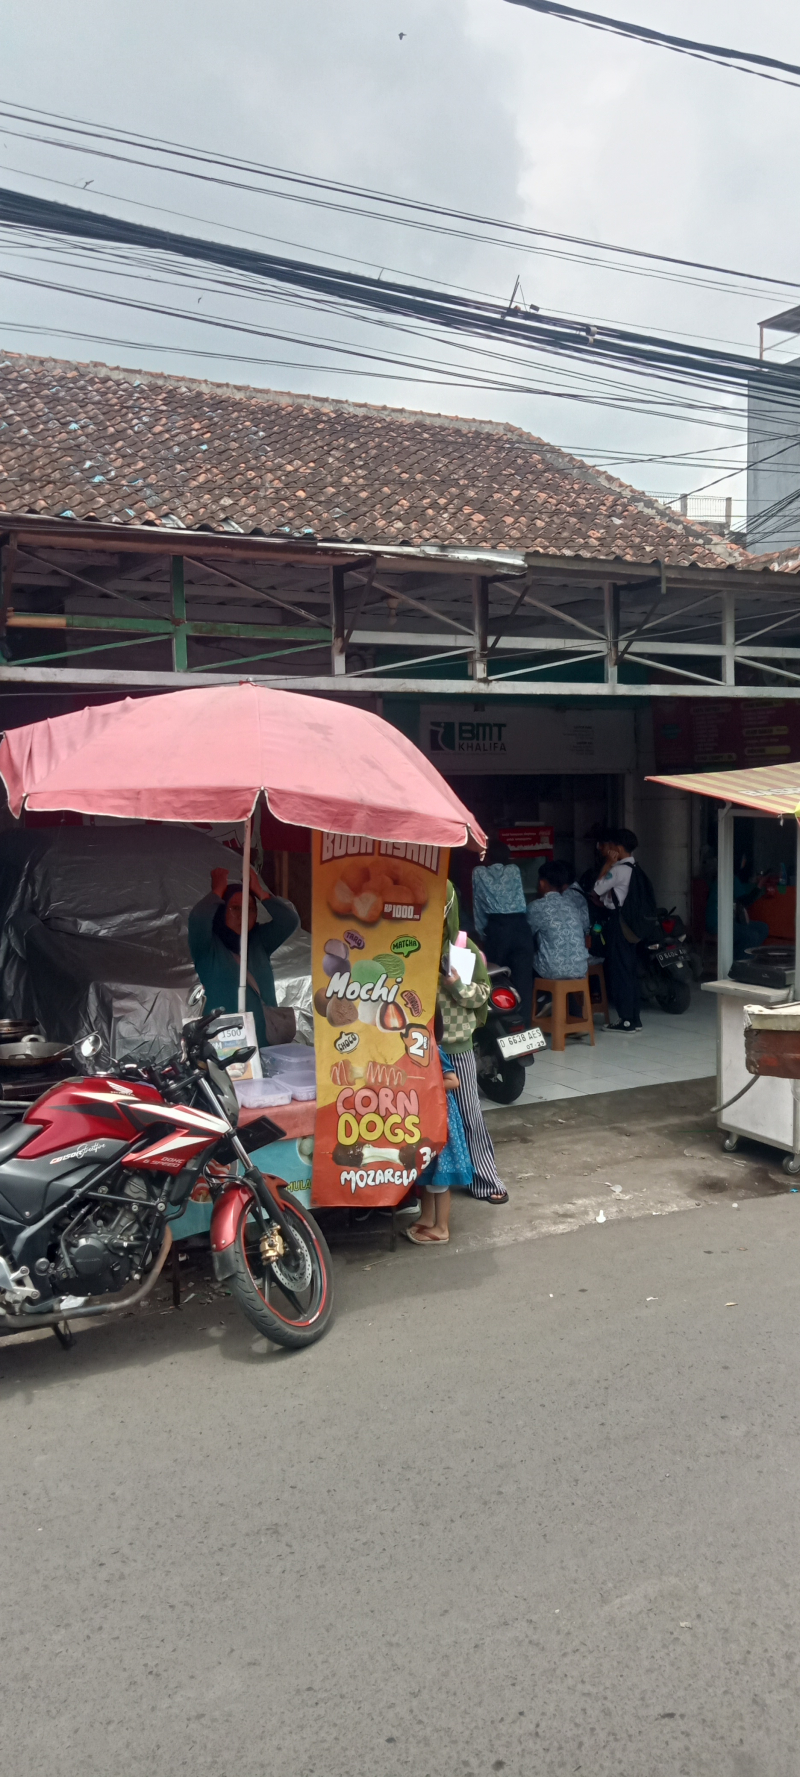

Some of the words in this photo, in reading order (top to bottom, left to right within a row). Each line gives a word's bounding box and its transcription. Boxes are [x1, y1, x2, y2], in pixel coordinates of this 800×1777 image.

[459, 722, 507, 741] BMT
[458, 742, 507, 752] KHALIFA
[346, 932, 363, 947] TARO
[392, 939, 417, 950] MATCHA
[325, 971, 403, 1003] Mochi
[222, 1030, 242, 1038] 1500
[337, 1033, 357, 1052] CHOCO
[527, 1029, 542, 1040] AES
[336, 1087, 419, 1120] CORN
[337, 1112, 421, 1146] DOGS
[340, 1168, 418, 1194] MOZARELA
